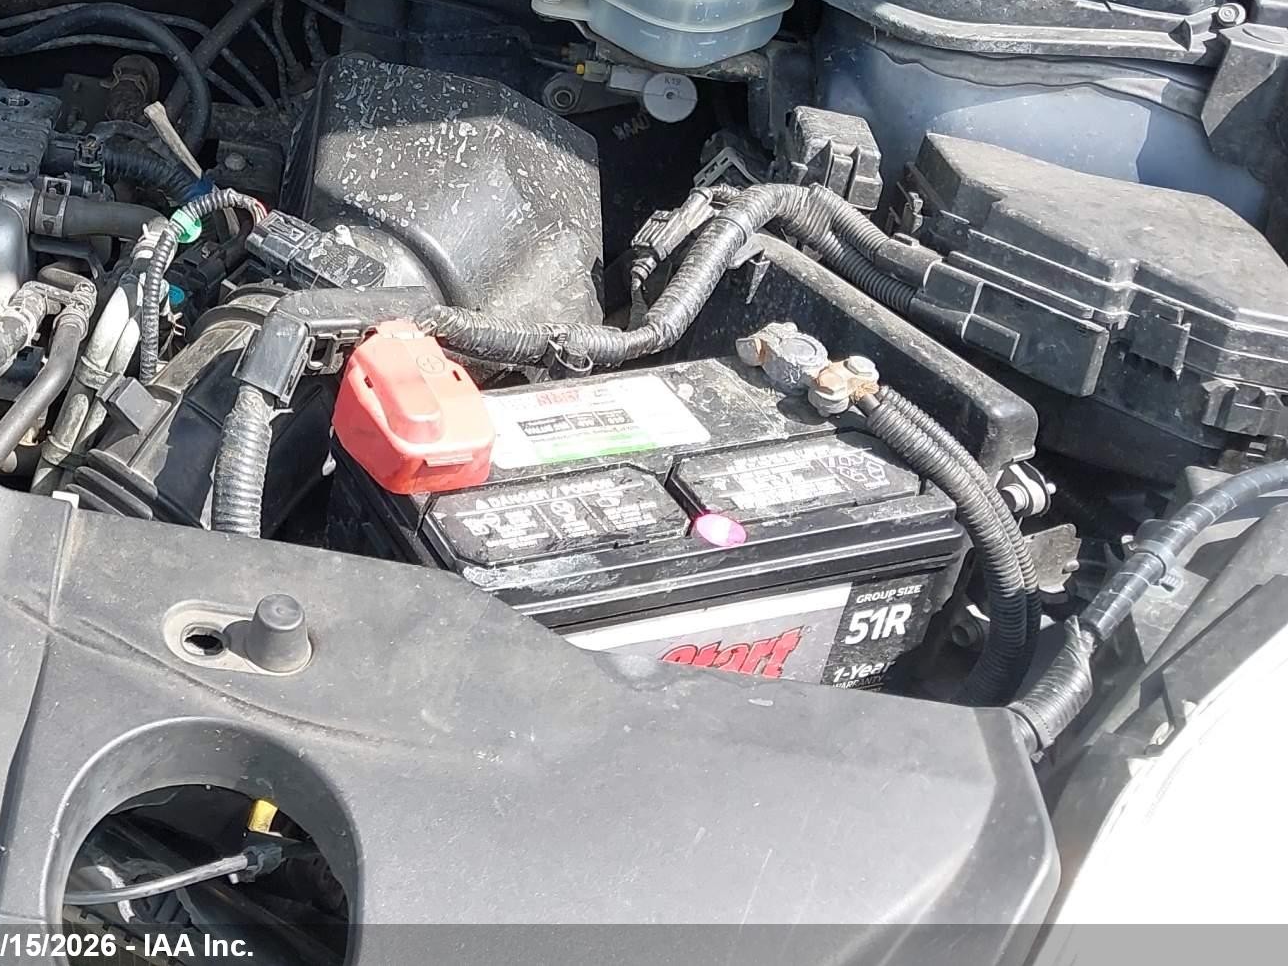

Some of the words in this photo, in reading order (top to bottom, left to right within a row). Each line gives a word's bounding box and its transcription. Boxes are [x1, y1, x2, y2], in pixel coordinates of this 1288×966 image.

[856, 588, 896, 604] GROUP
[897, 584, 922, 597] SIZE
[844, 603, 912, 645] 51R
[833, 660, 896, 682] 1-Year
